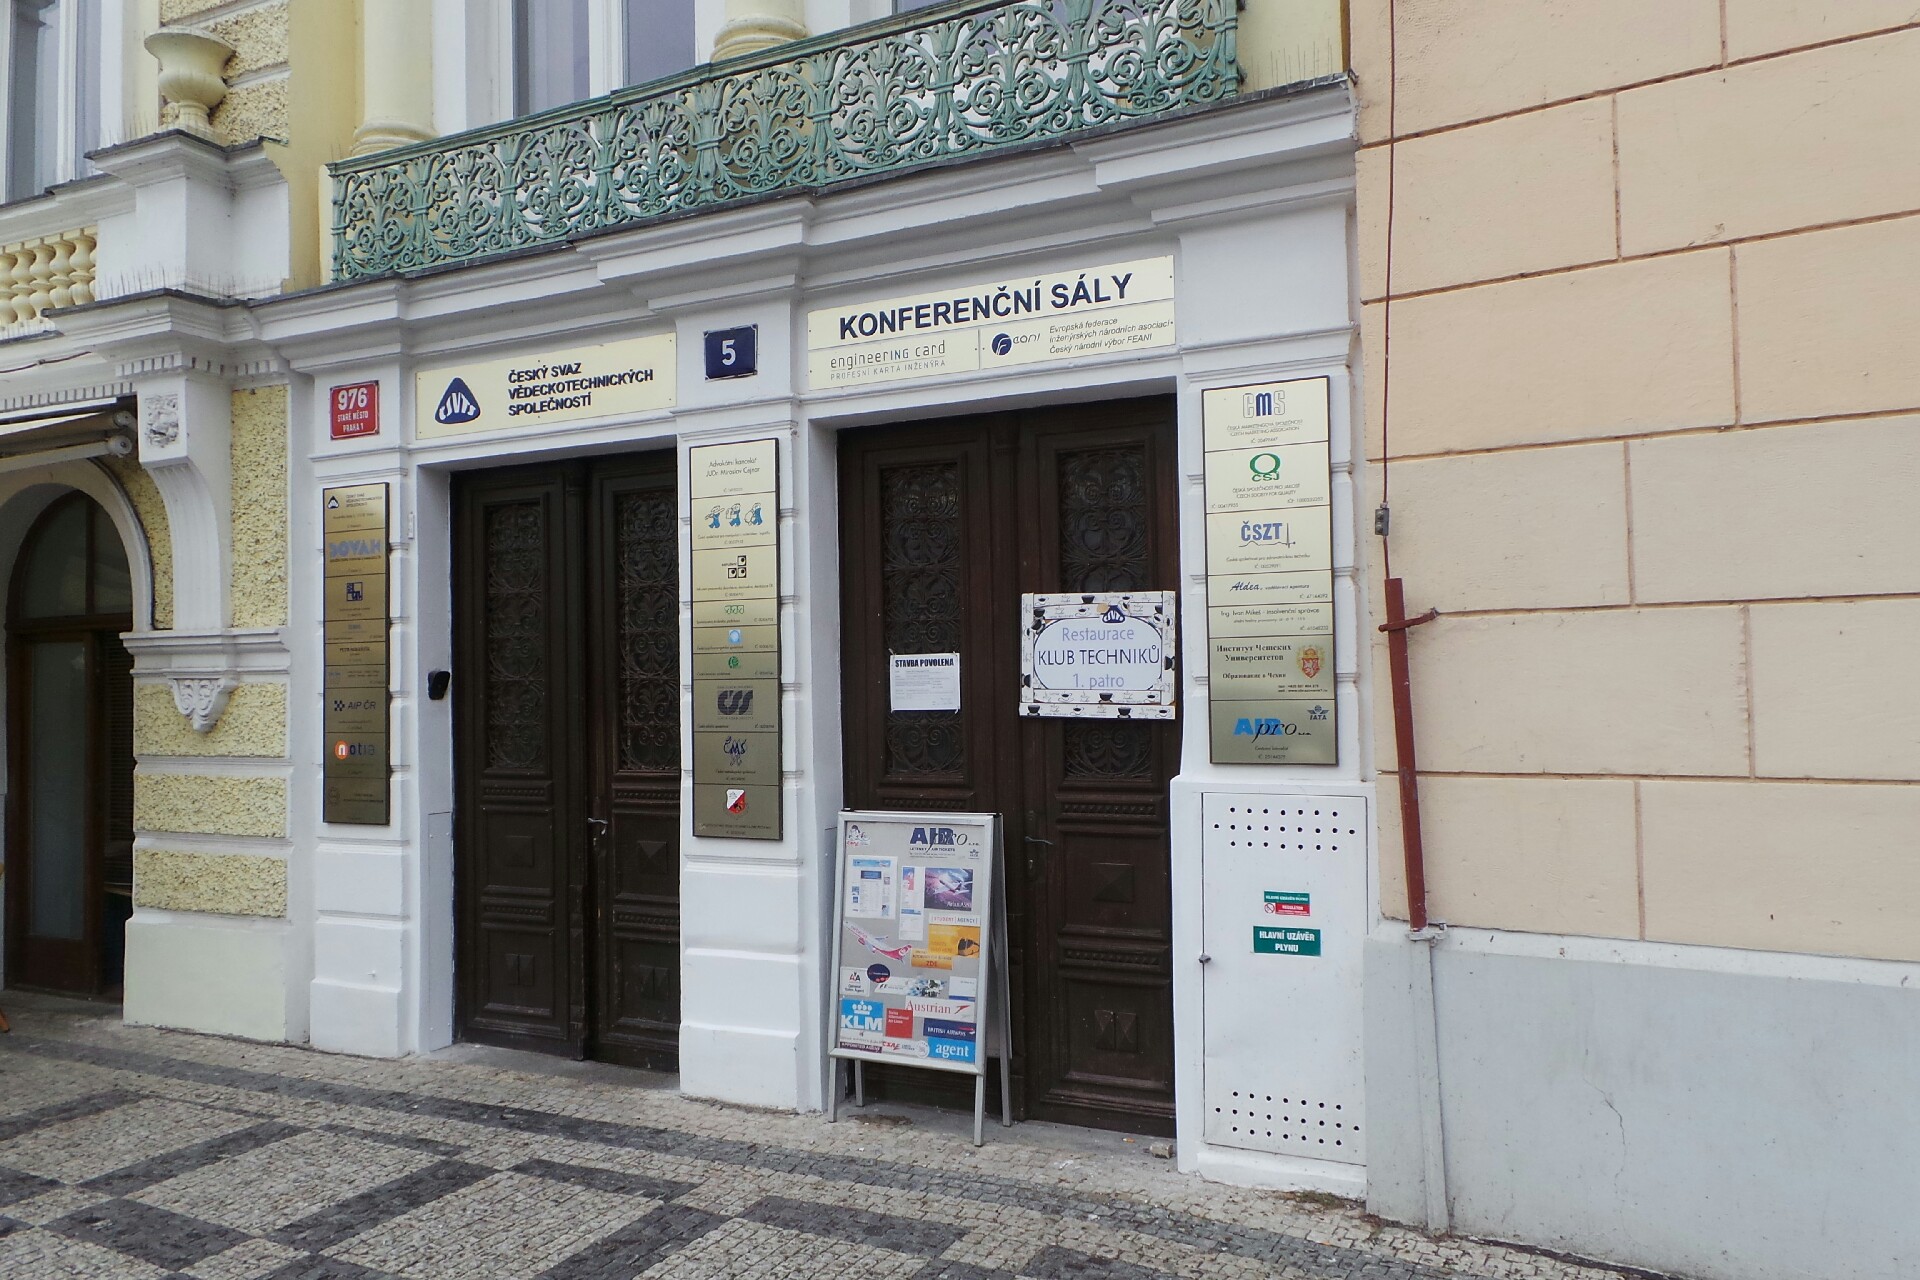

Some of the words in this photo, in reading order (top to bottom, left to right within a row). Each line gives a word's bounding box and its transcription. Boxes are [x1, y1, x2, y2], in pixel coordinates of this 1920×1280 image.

[839, 280, 1042, 340] KONFERENČNÍ
[1050, 273, 1133, 309] SÁLY
[1049, 322, 1084, 334] Evropská
[1085, 318, 1118, 329] federace
[1099, 325, 1136, 336] národních
[1138, 320, 1171, 331] asociací
[1049, 345, 1071, 355] Český
[1073, 341, 1102, 351] národní
[1104, 338, 1126, 349] výbor
[1127, 333, 1153, 344] FEANI
[722, 339, 736, 366] 5
[830, 348, 909, 370] engineerING
[915, 340, 945, 357] card
[508, 365, 548, 383] ČESKÝ
[550, 362, 582, 378] SVAZ
[830, 368, 870, 380] PROFESNÍ
[873, 365, 901, 375] KARTA
[904, 360, 946, 371] INŽENÝRA
[508, 368, 653, 400] VĚDECKOTECHNICKÝCH
[338, 387, 368, 410] 976
[508, 391, 592, 416] SPOLEČNOSTÍ
[337, 411, 351, 422] STARÉ
[352, 409, 369, 421] MĚSTO
[342, 422, 360, 433] PRAHA
[1241, 520, 1283, 541] ČSZT
[1062, 627, 1134, 641] Restaurace
[1038, 650, 1075, 665] KLUB
[1080, 645, 1159, 665] TECHNIKŮ
[1216, 644, 1253, 653] Институт
[1255, 643, 1292, 651] Чешских
[895, 659, 919, 667] STAVBA
[920, 658, 954, 667] POVOLENA
[1073, 674, 1084, 688] 1.
[1090, 674, 1125, 690] patro
[347, 701, 362, 710] AIP
[363, 699, 376, 710] ČR
[1252, 723, 1297, 744] pro
[934, 915, 955, 923] STUDENT
[957, 916, 976, 924] AGENCY
[1259, 929, 1284, 940] HLAVNÍ
[1286, 931, 1315, 941] UZÁVĚR
[1275, 943, 1299, 952] PLYNU
[905, 999, 951, 1015] Austrian
[840, 1014, 883, 1031] KLM
[927, 1026, 945, 1034] BRITISH
[946, 1028, 966, 1037] AIRWAYS
[935, 1044, 969, 1059] agent
